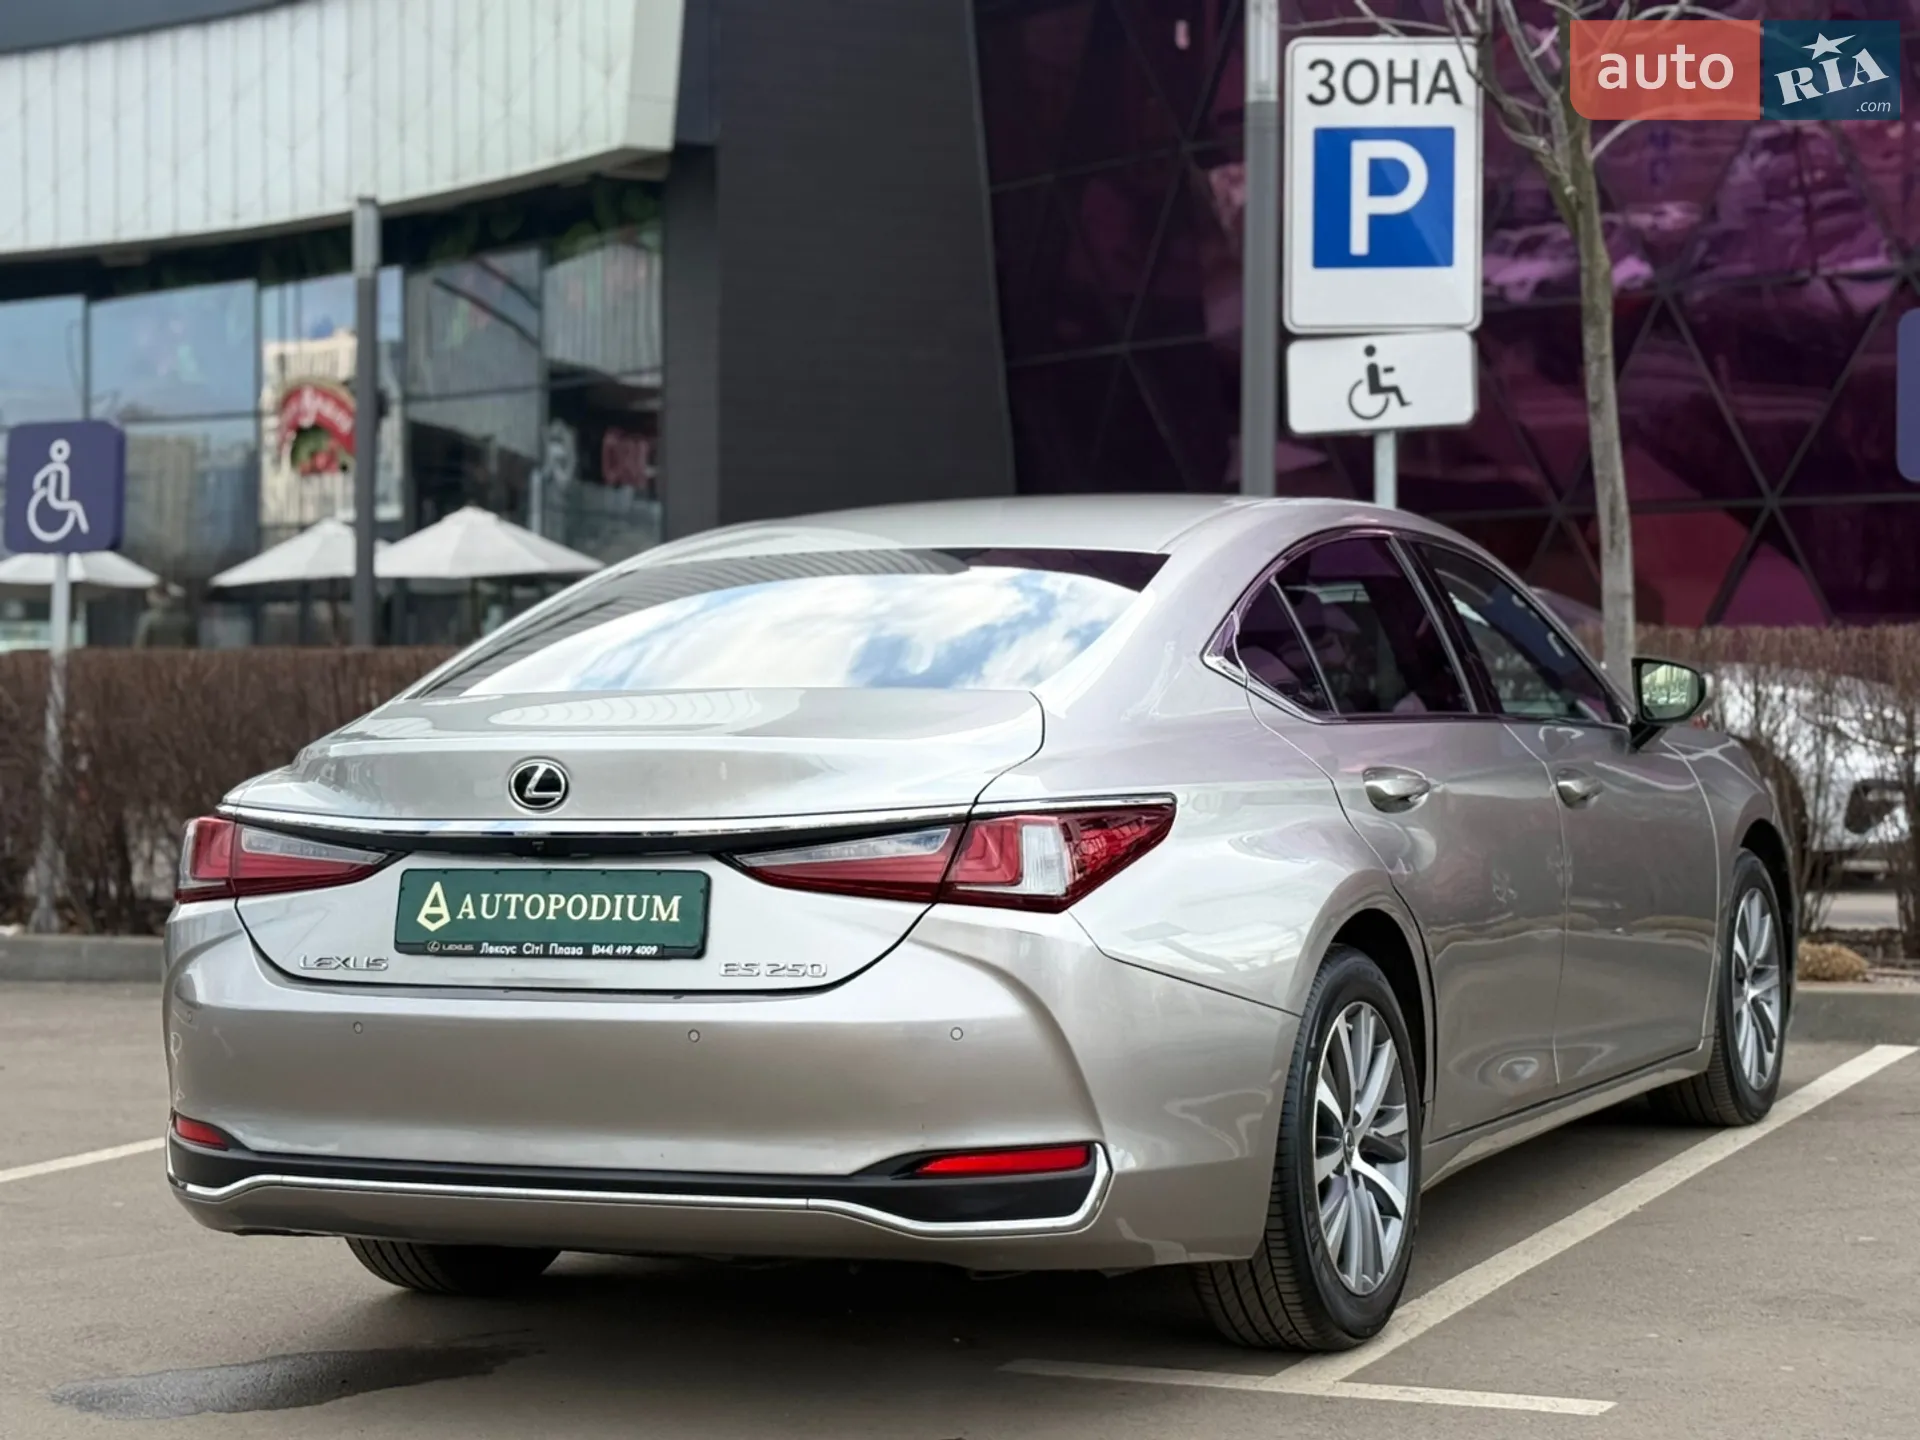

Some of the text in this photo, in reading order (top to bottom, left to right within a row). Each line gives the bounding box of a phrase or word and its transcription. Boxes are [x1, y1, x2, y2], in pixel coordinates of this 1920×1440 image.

[1307, 58, 1463, 106] ЗОНА
[1350, 139, 1428, 256] P
[456, 893, 682, 922] AUTOPODIUM
[480, 942, 658, 956] Лексус Сіті Плаза (044) 499 4009
[300, 954, 388, 971] LEXUS
[719, 961, 828, 978] ES 250
